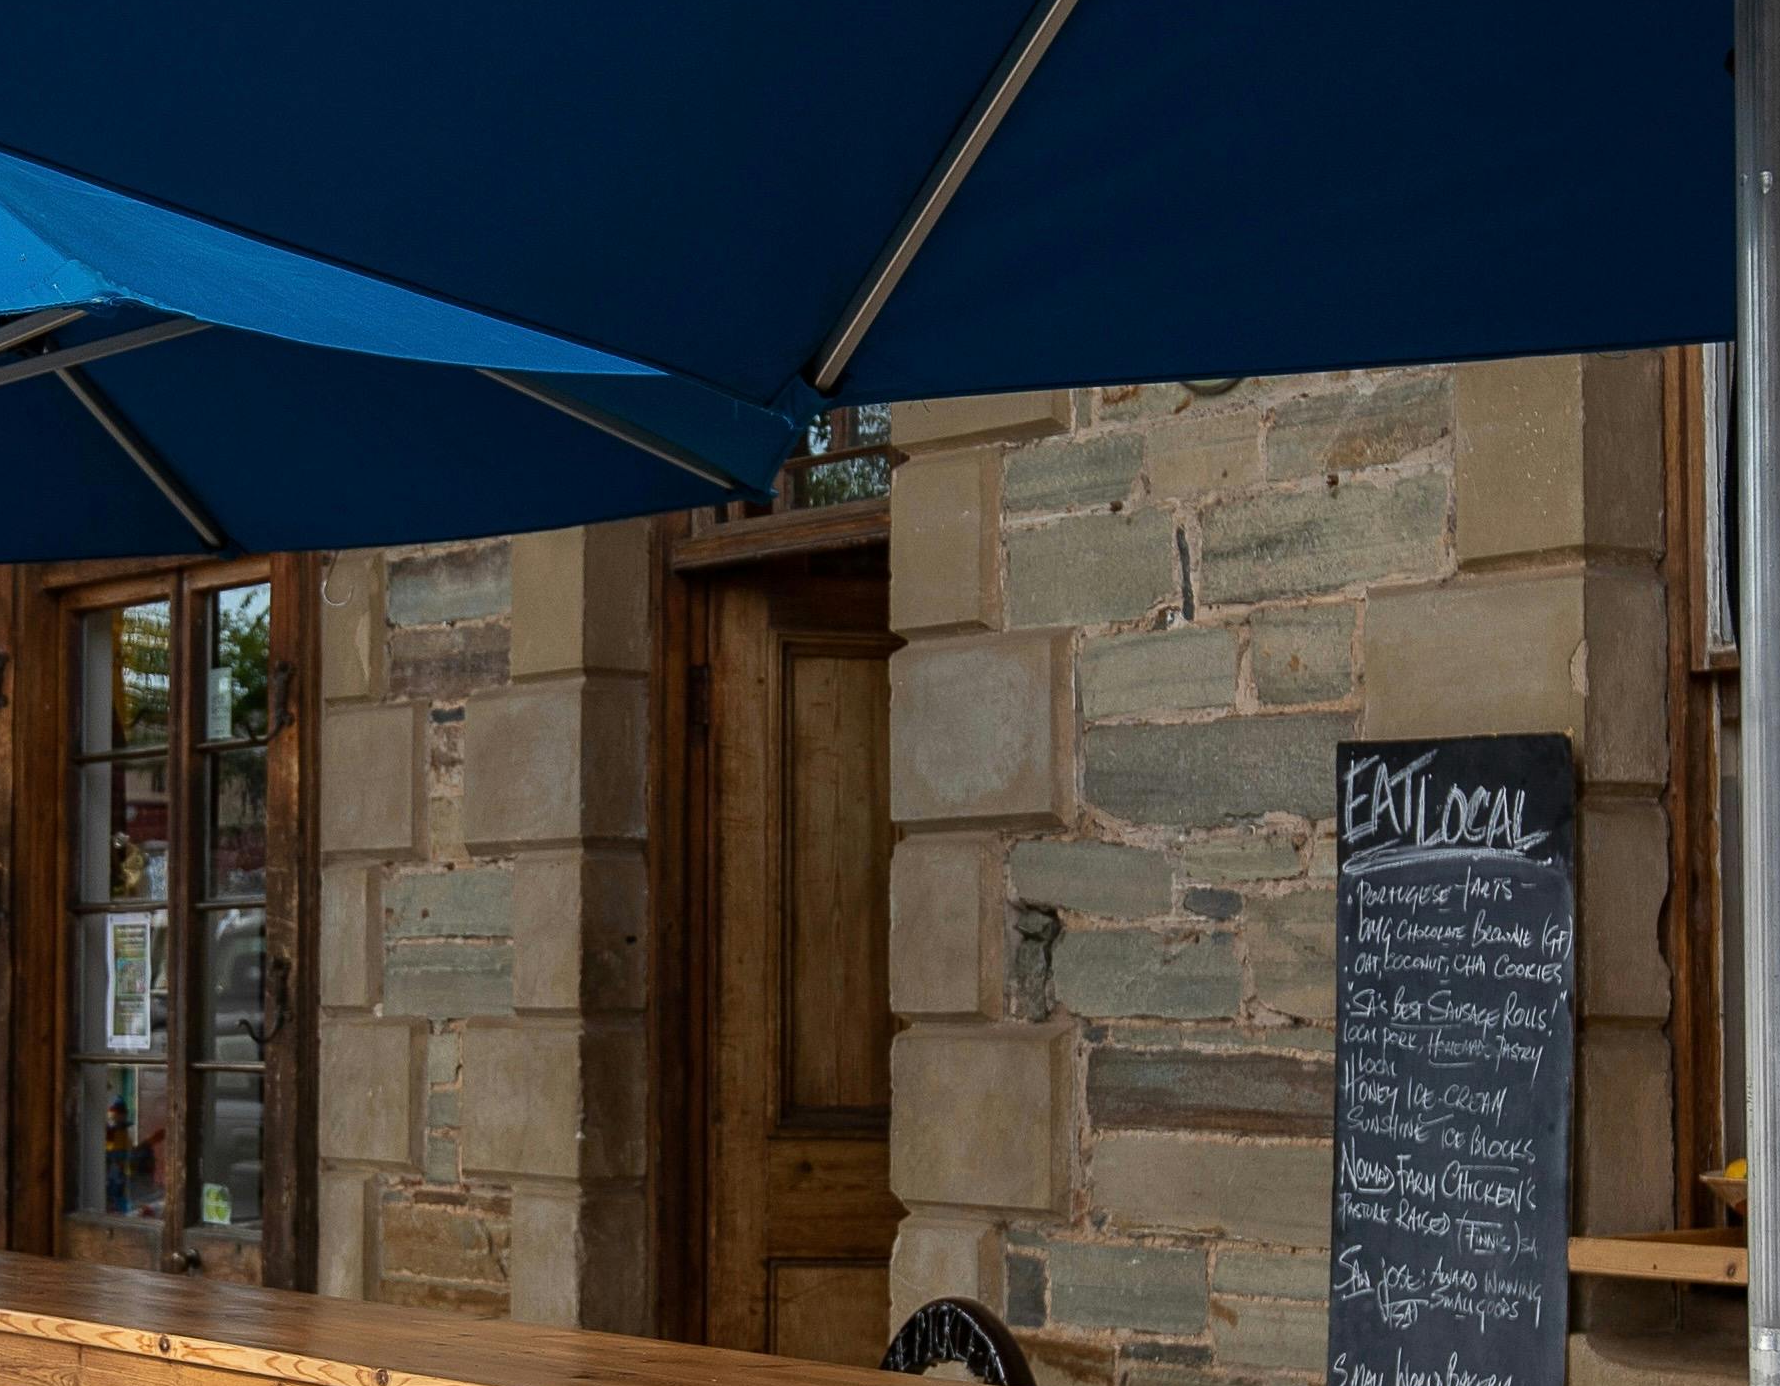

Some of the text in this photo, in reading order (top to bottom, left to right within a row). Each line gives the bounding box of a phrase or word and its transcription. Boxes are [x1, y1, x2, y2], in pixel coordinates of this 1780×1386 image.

[1342, 747, 1552, 853] EAT LOCAL
[1494, 954, 1563, 986] COOKIES
[1470, 1124, 1536, 1163] BLOCKS
[1396, 1154, 1436, 1202] FARM
[1430, 1256, 1477, 1291] AWARD
